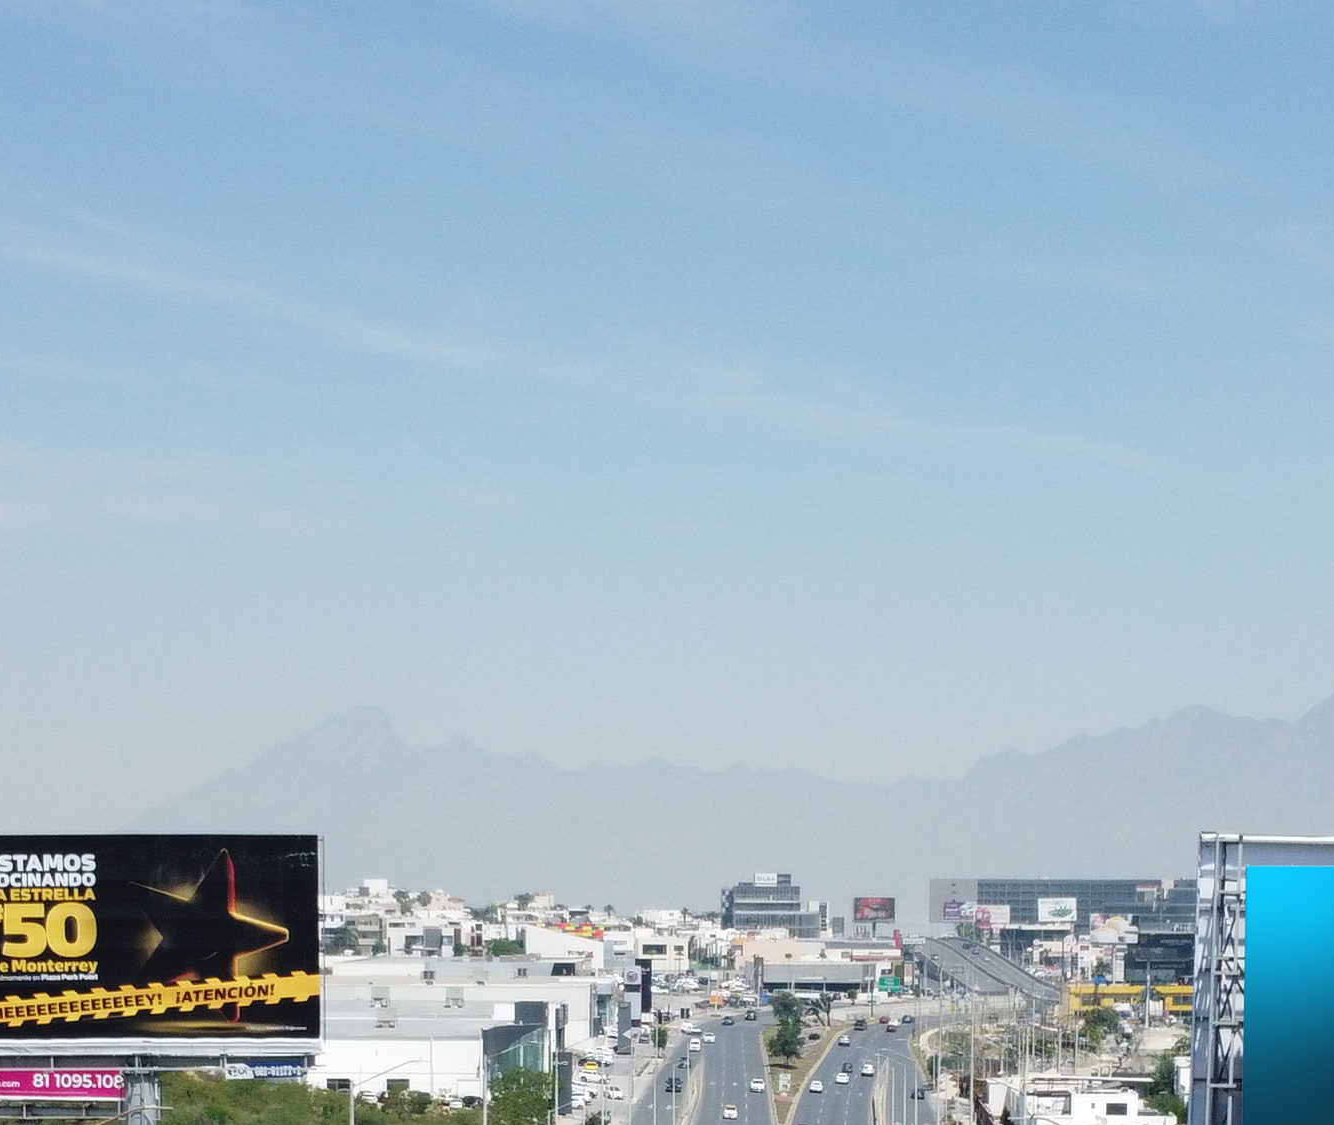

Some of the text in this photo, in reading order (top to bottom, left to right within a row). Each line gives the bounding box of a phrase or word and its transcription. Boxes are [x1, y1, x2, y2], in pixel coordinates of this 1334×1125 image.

[10, 888, 96, 901] ESTRELLA
[11, 959, 98, 974] Monterrey
[175, 983, 275, 1004] ¡ATENCIÓN!
[32, 1073, 50, 1088] 81
